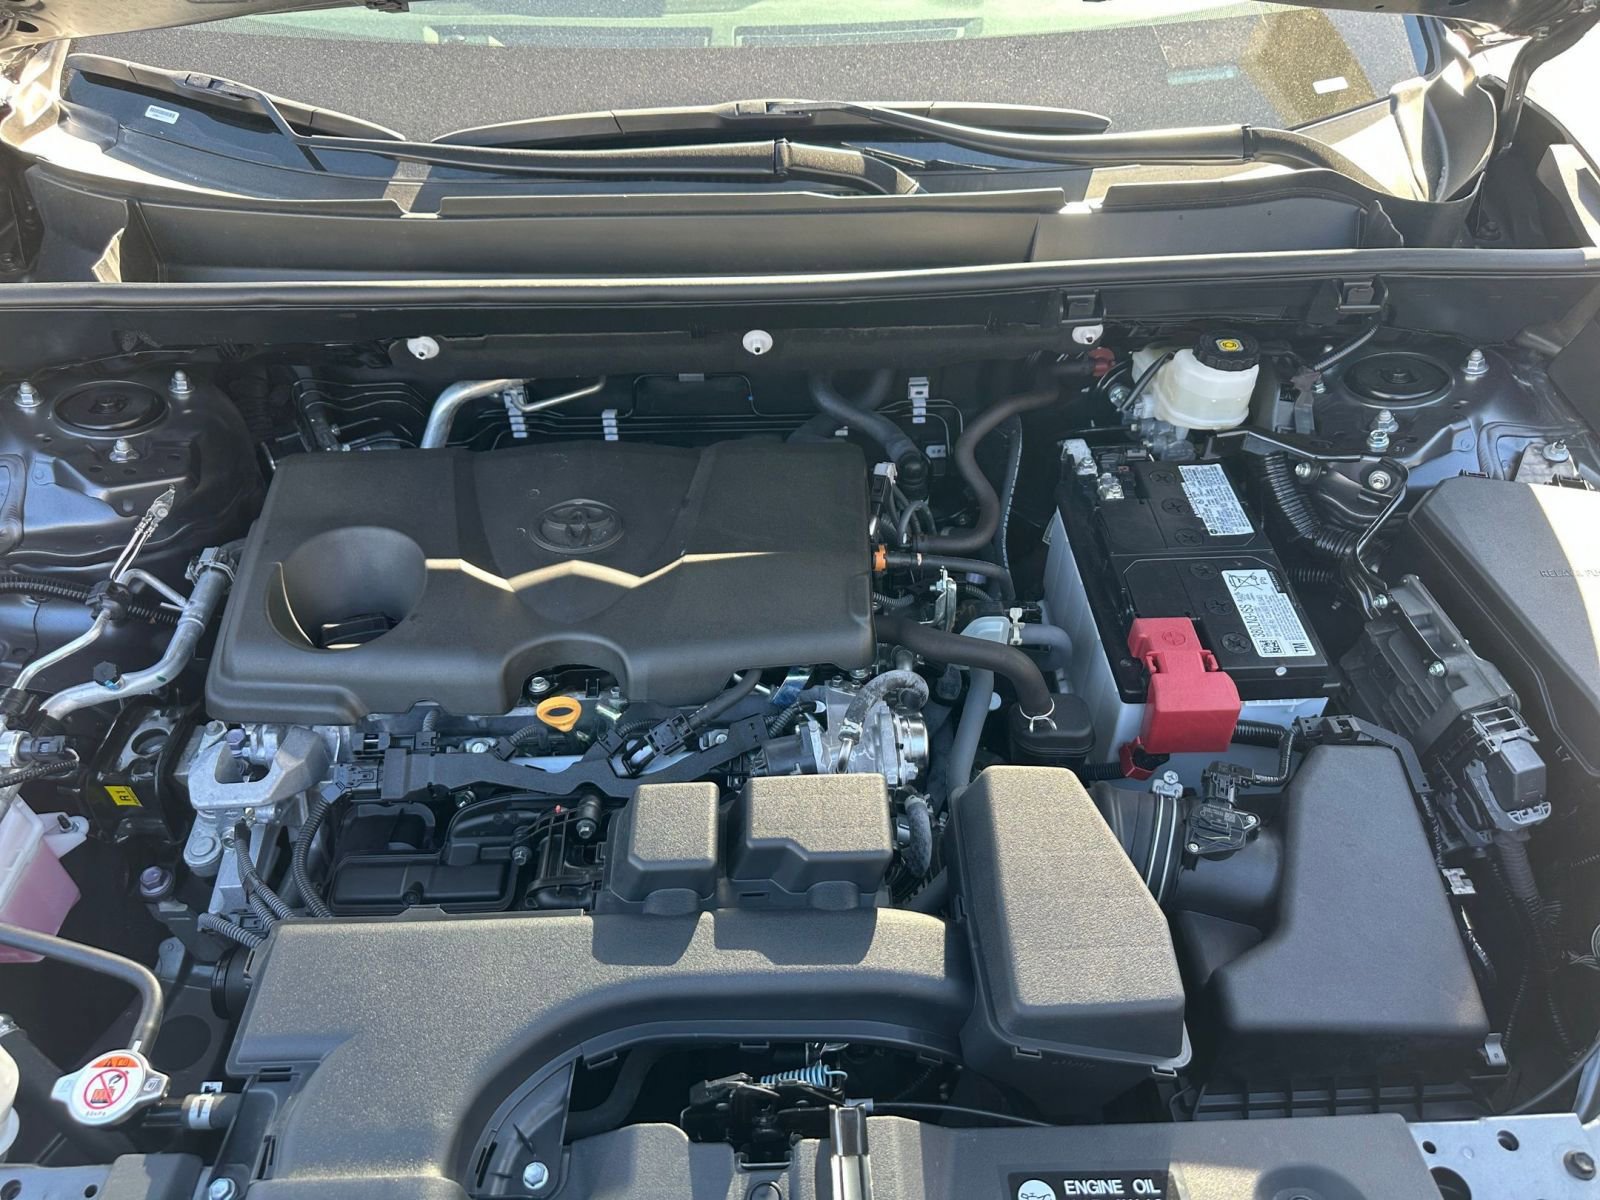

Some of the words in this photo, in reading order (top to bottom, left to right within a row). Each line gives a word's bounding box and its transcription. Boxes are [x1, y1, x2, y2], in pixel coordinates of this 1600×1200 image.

[1291, 642, 1309, 653] TM
[1063, 1180, 1124, 1194] ENGINE
[1132, 1179, 1161, 1194] OIL
